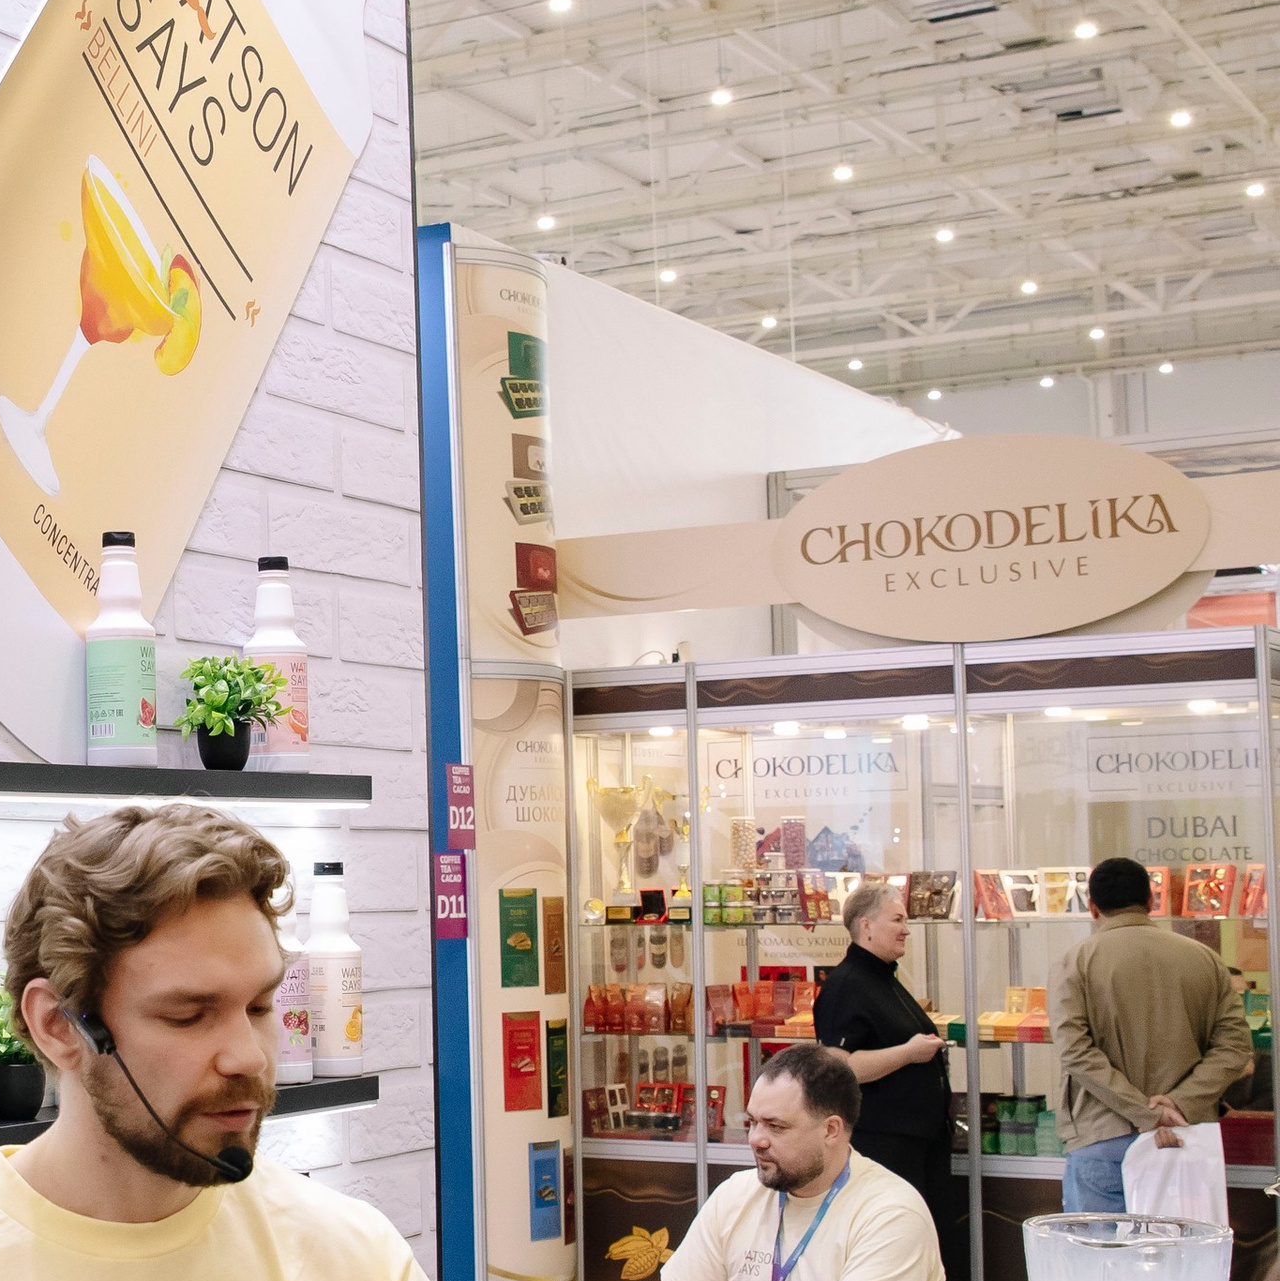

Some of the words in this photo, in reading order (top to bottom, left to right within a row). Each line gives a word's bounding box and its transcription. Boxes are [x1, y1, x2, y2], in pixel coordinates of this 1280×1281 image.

[87, 26, 159, 158] BELLINI
[32, 504, 101, 597] CONCENTRA
[885, 556, 1091, 593] EXCLUSIVE
[451, 766, 470, 776] COFFEE
[452, 776, 462, 784] TEA
[453, 786, 470, 794] CACAO
[764, 787, 850, 799] EXCLUSIVE
[1146, 781, 1235, 794] EXCLUSIVE
[449, 806, 475, 830] D12
[1147, 815, 1238, 839] DUBAI
[440, 856, 461, 864] COFFEE
[1134, 846, 1253, 862] CHOCOLATE
[440, 865, 451, 873] TEA
[441, 874, 462, 883] CACAO
[437, 895, 466, 919] D11
[737, 937, 793, 947] ШКОЛАД
[807, 937, 851, 947] УКРАШЕ
[280, 982, 306, 994] SAYS
[744, 1250, 772, 1265] ATSO
[738, 1263, 760, 1277] AYS
